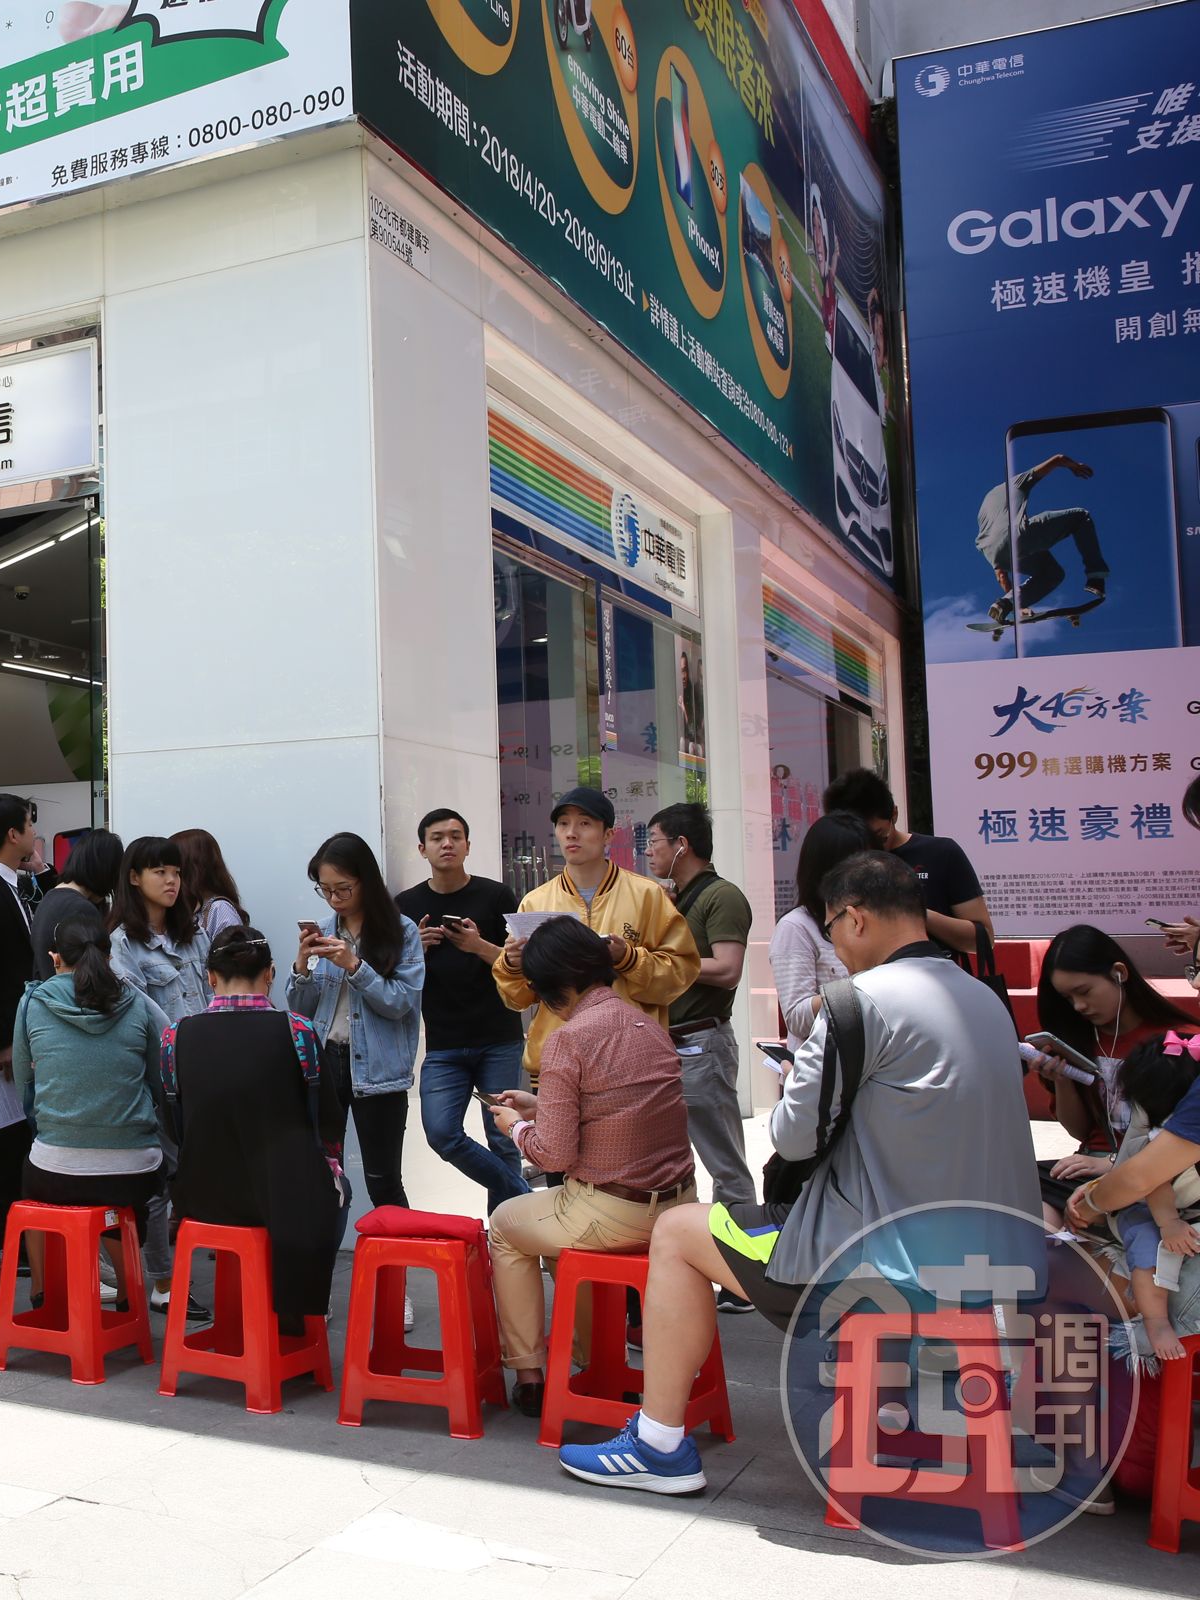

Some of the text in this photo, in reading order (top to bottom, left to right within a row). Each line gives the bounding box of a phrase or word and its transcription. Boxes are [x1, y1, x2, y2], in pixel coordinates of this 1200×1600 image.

[614, 27, 634, 70] 60台
[957, 54, 1025, 78] 中華電信
[567, 54, 630, 141] emoving Shine
[958, 69, 1025, 87] Chunghwa Telecom
[946, 183, 1194, 256] Galaxy
[991, 260, 1154, 312] 極速機皇
[643, 527, 686, 580] 中華電信
[989, 685, 1152, 737] 大4G方案
[978, 802, 1174, 844] 極速豪禮
